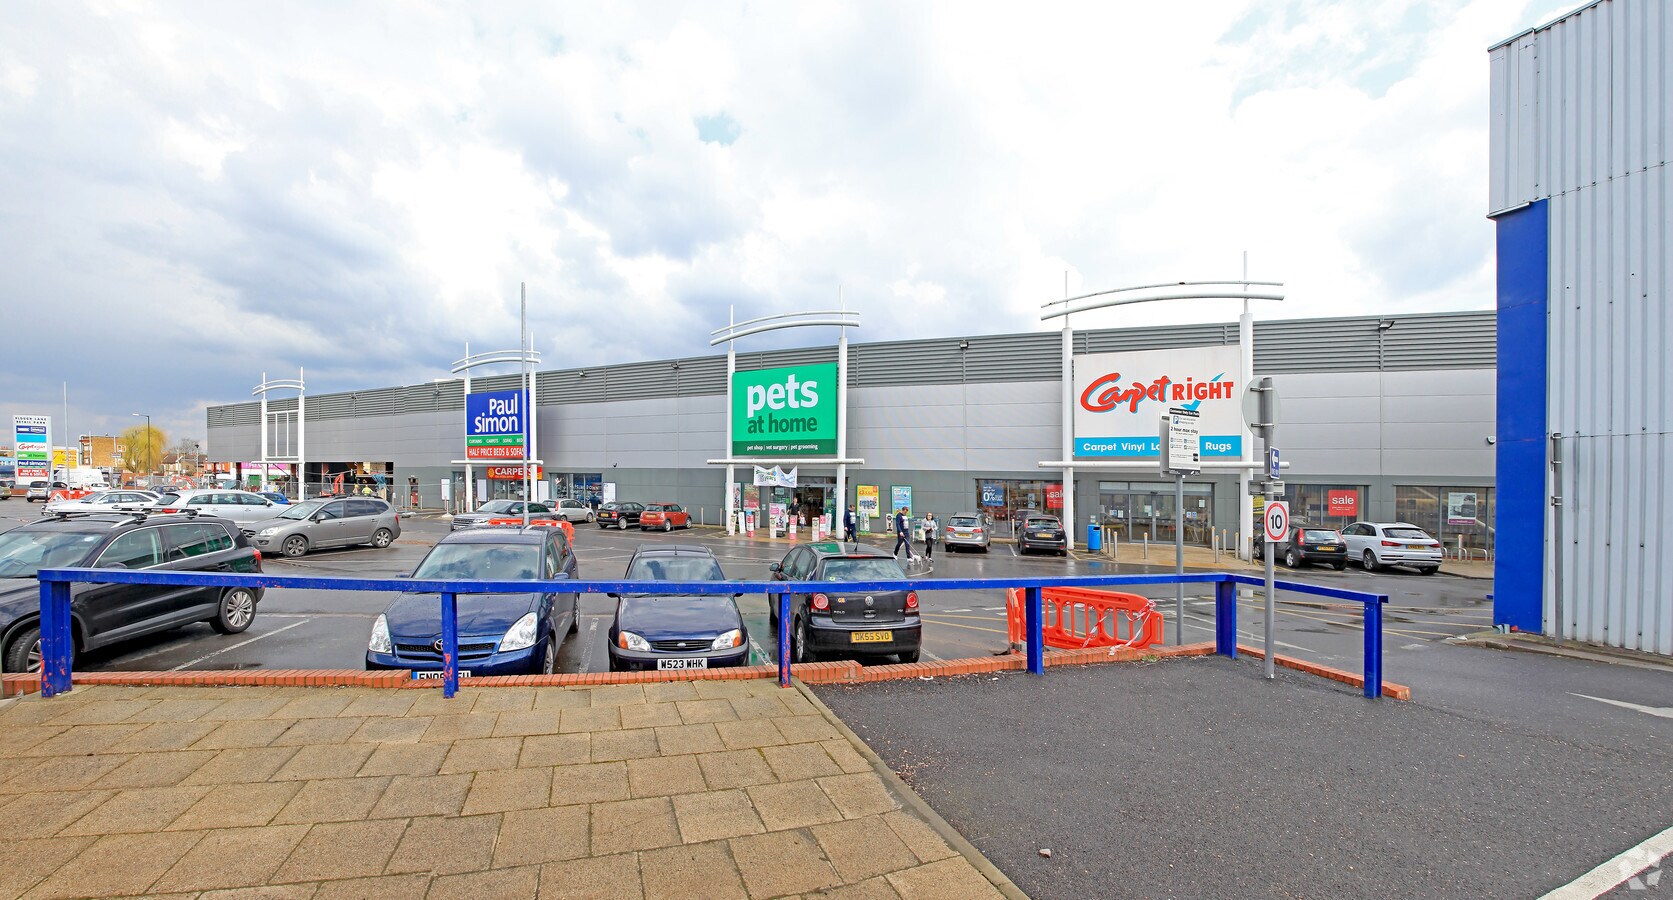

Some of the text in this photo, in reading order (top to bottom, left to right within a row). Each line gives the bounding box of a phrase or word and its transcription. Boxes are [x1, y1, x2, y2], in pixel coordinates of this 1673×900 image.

[747, 373, 819, 418] pets
[1080, 372, 1172, 414] Carpet
[489, 393, 518, 415] Paul
[747, 413, 818, 434] at home
[469, 448, 480, 456] HALF
[481, 448, 493, 456] PRICE
[494, 448, 505, 456] BEDS
[506, 448, 510, 456] &
[1083, 442, 1117, 452] Carpet
[1121, 442, 1145, 452] Vinyl
[1205, 442, 1232, 452] Rugs
[1049, 490, 1064, 499] sal
[1331, 495, 1354, 505] sale
[1271, 514, 1283, 530] 10
[855, 633, 874, 641] DK55
[661, 659, 704, 669] W523 WHK
